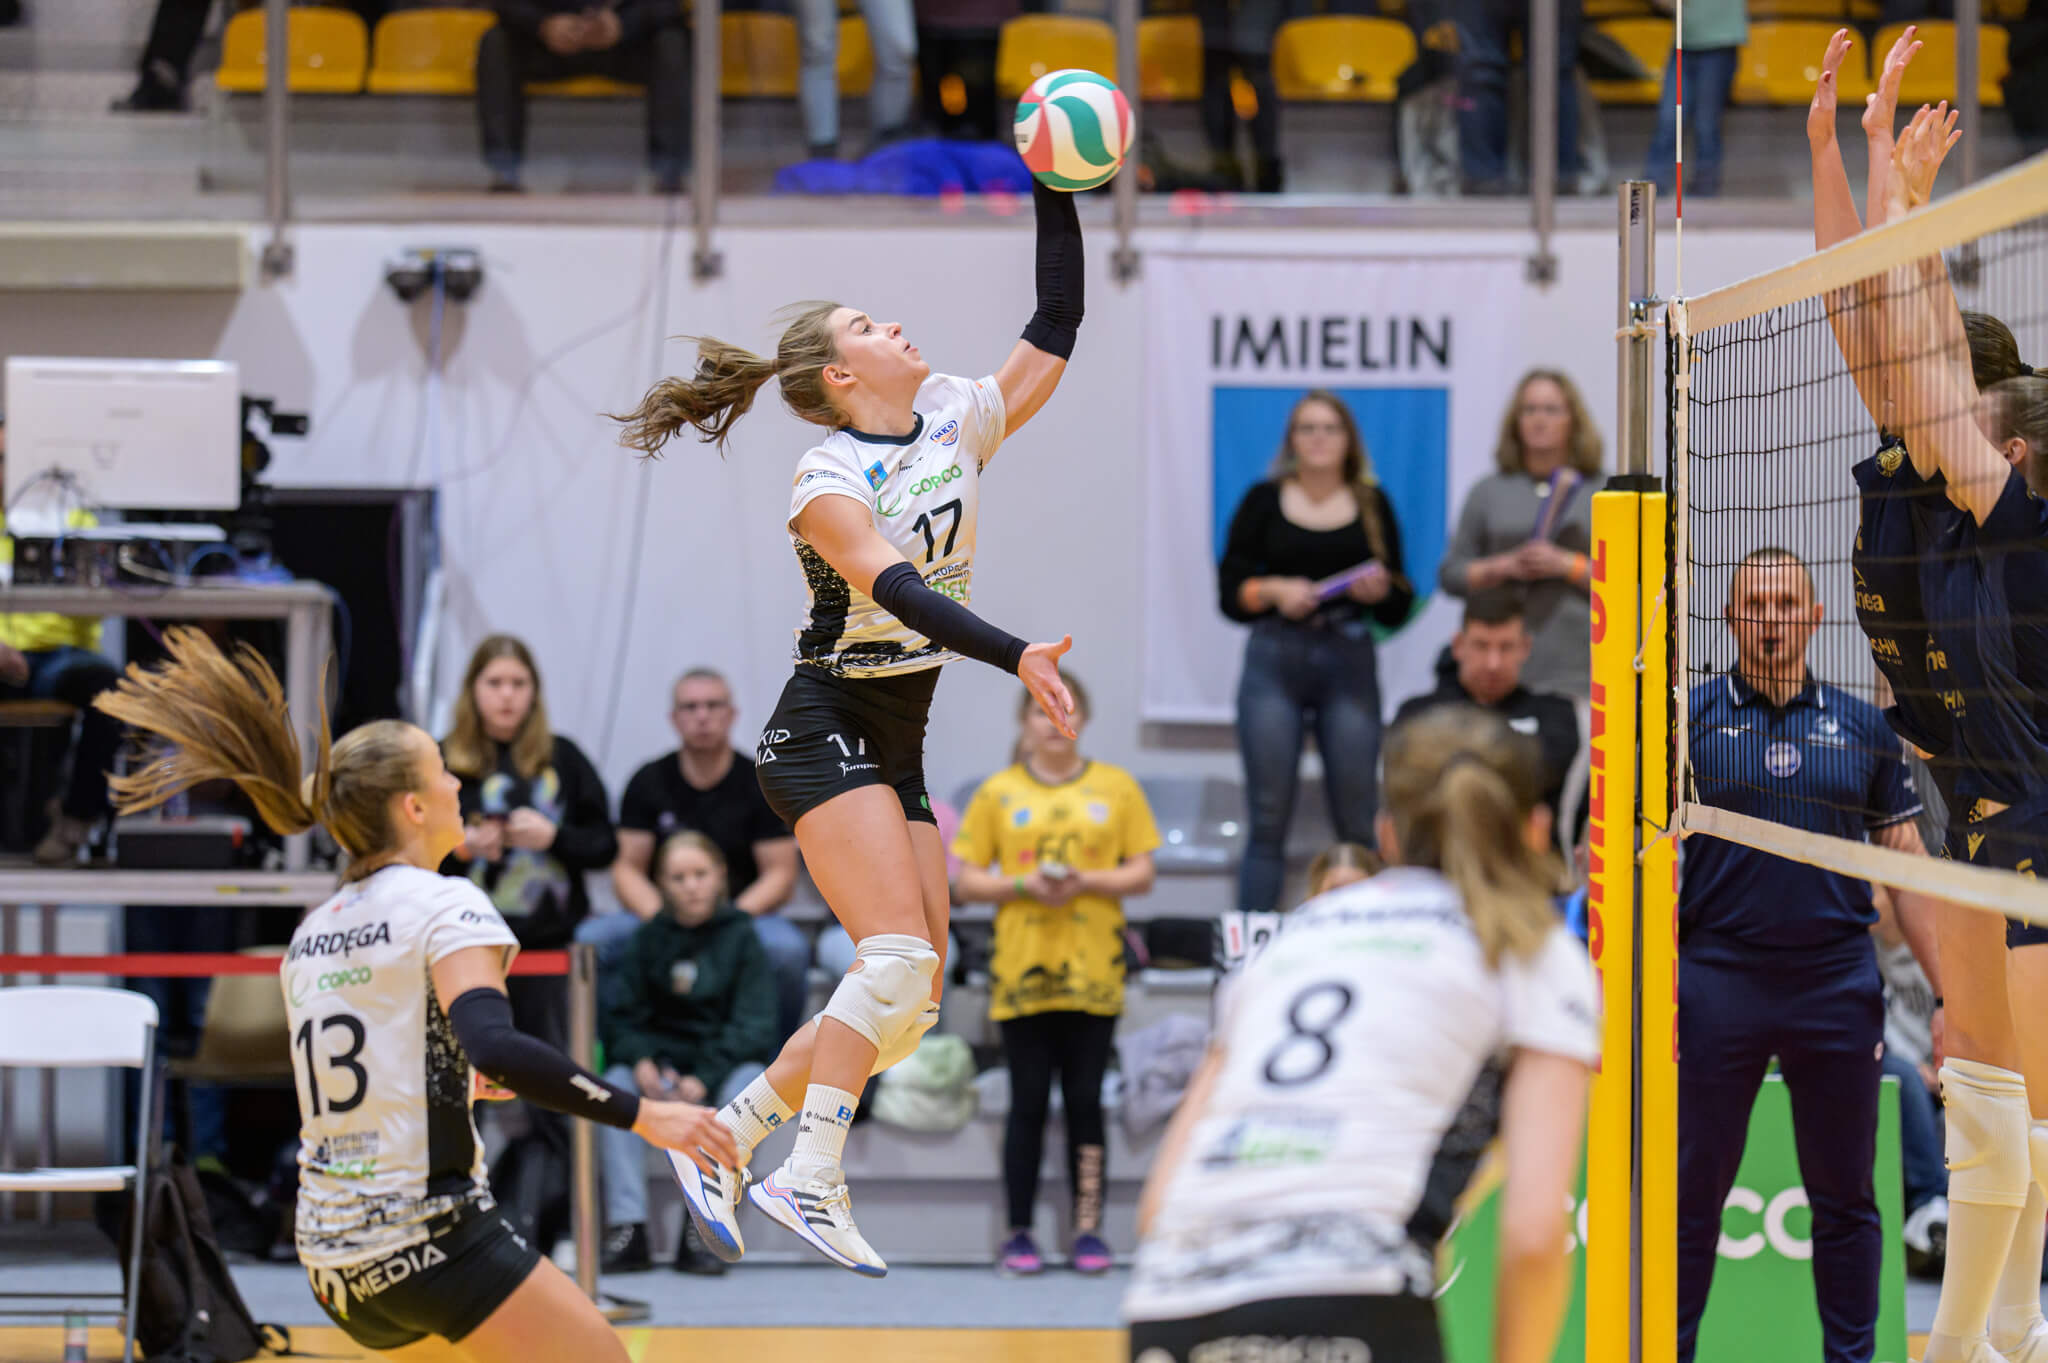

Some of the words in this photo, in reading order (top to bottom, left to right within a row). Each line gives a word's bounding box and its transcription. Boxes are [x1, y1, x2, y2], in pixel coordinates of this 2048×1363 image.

[1212, 315, 1450, 370] IMIELIN
[934, 423, 954, 439] MKS
[909, 464, 963, 496] COPCO
[912, 498, 962, 563] 17
[317, 965, 372, 991] COPCO
[1262, 977, 1355, 1088] 8
[296, 1014, 368, 1118] 13
[349, 1243, 448, 1303] MEDIA
